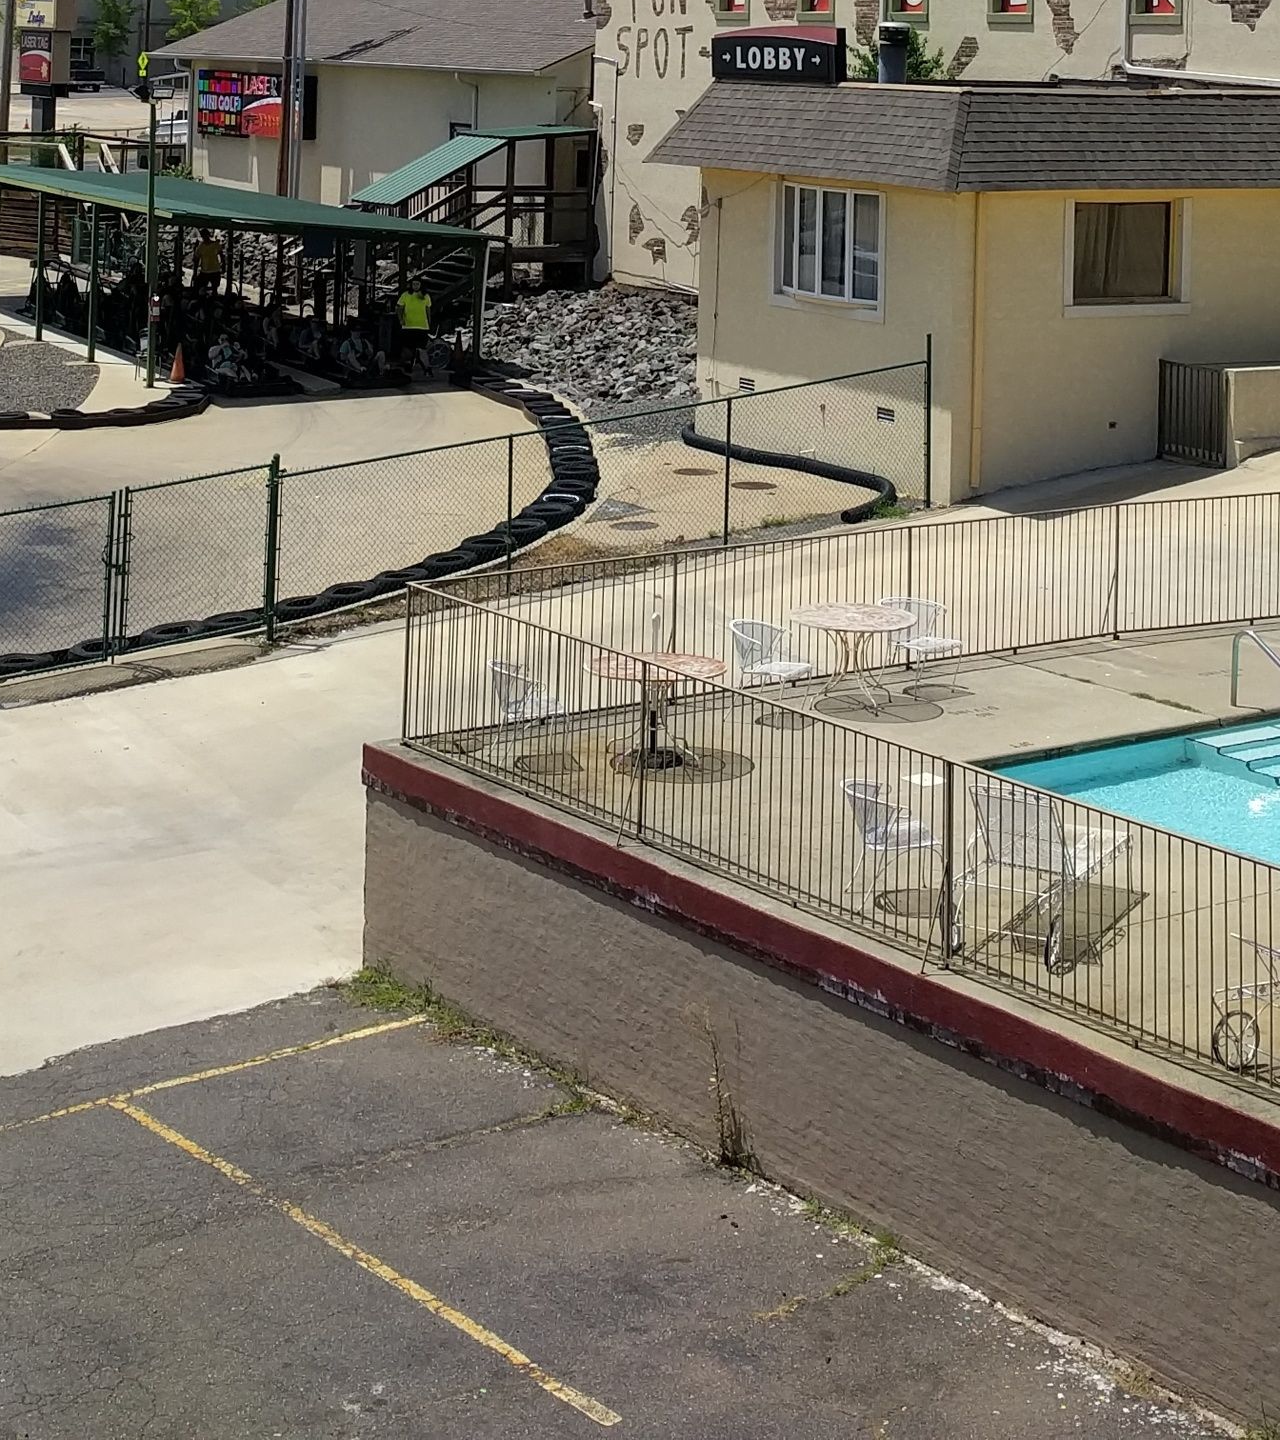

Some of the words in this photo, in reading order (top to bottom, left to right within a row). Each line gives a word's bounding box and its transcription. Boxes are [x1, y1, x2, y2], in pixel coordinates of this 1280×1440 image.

[21, 35, 37, 49] LASER
[617, 25, 693, 79] SPOT
[735, 46, 806, 71] LOBBY
[243, 75, 278, 96] LASER
[199, 93, 218, 110] MINI
